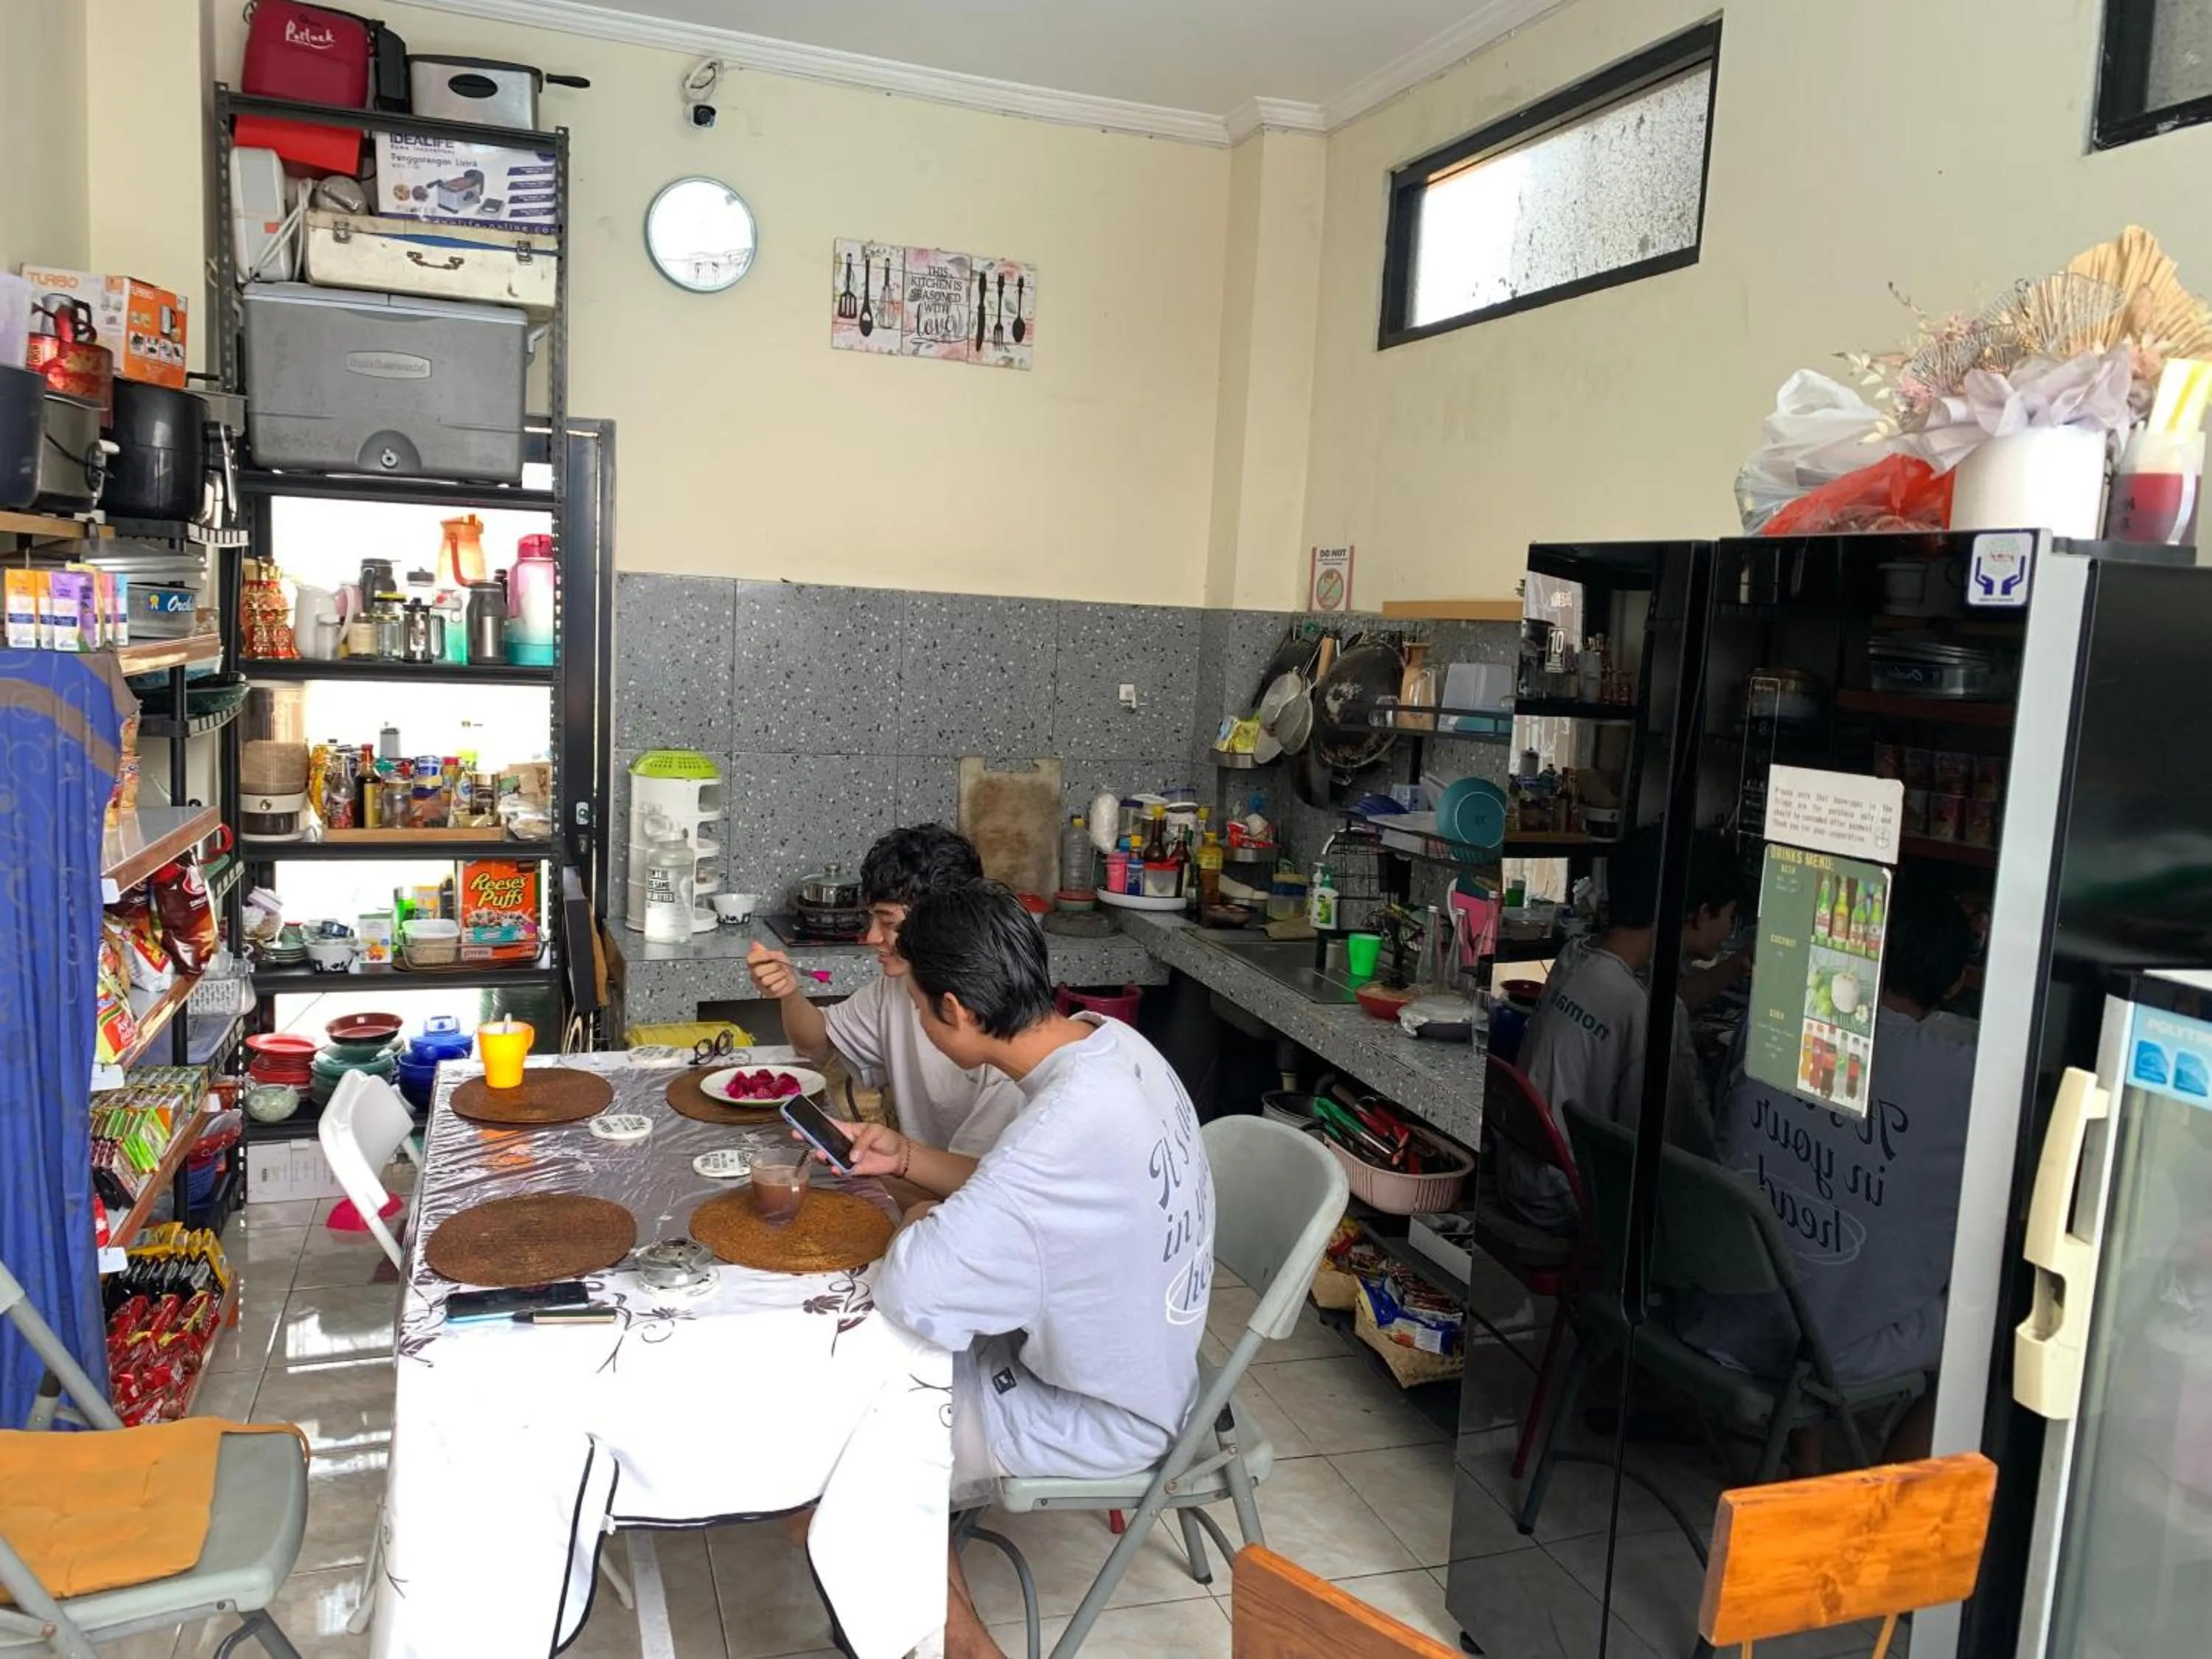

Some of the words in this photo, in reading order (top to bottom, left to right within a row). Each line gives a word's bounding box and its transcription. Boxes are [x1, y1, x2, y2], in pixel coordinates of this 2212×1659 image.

[928, 265, 949, 278] THIS
[27, 271, 79, 289] TURBO
[911, 275, 952, 291] KITCHEN
[953, 281, 962, 291] IS
[910, 288, 961, 303] SEASONED
[923, 301, 950, 315] WITH
[1319, 549, 1331, 558] DO
[1332, 547, 1347, 557] NOT
[469, 872, 529, 891] Reese's
[477, 888, 525, 910] Puffs
[1163, 1209, 1191, 1263] in
